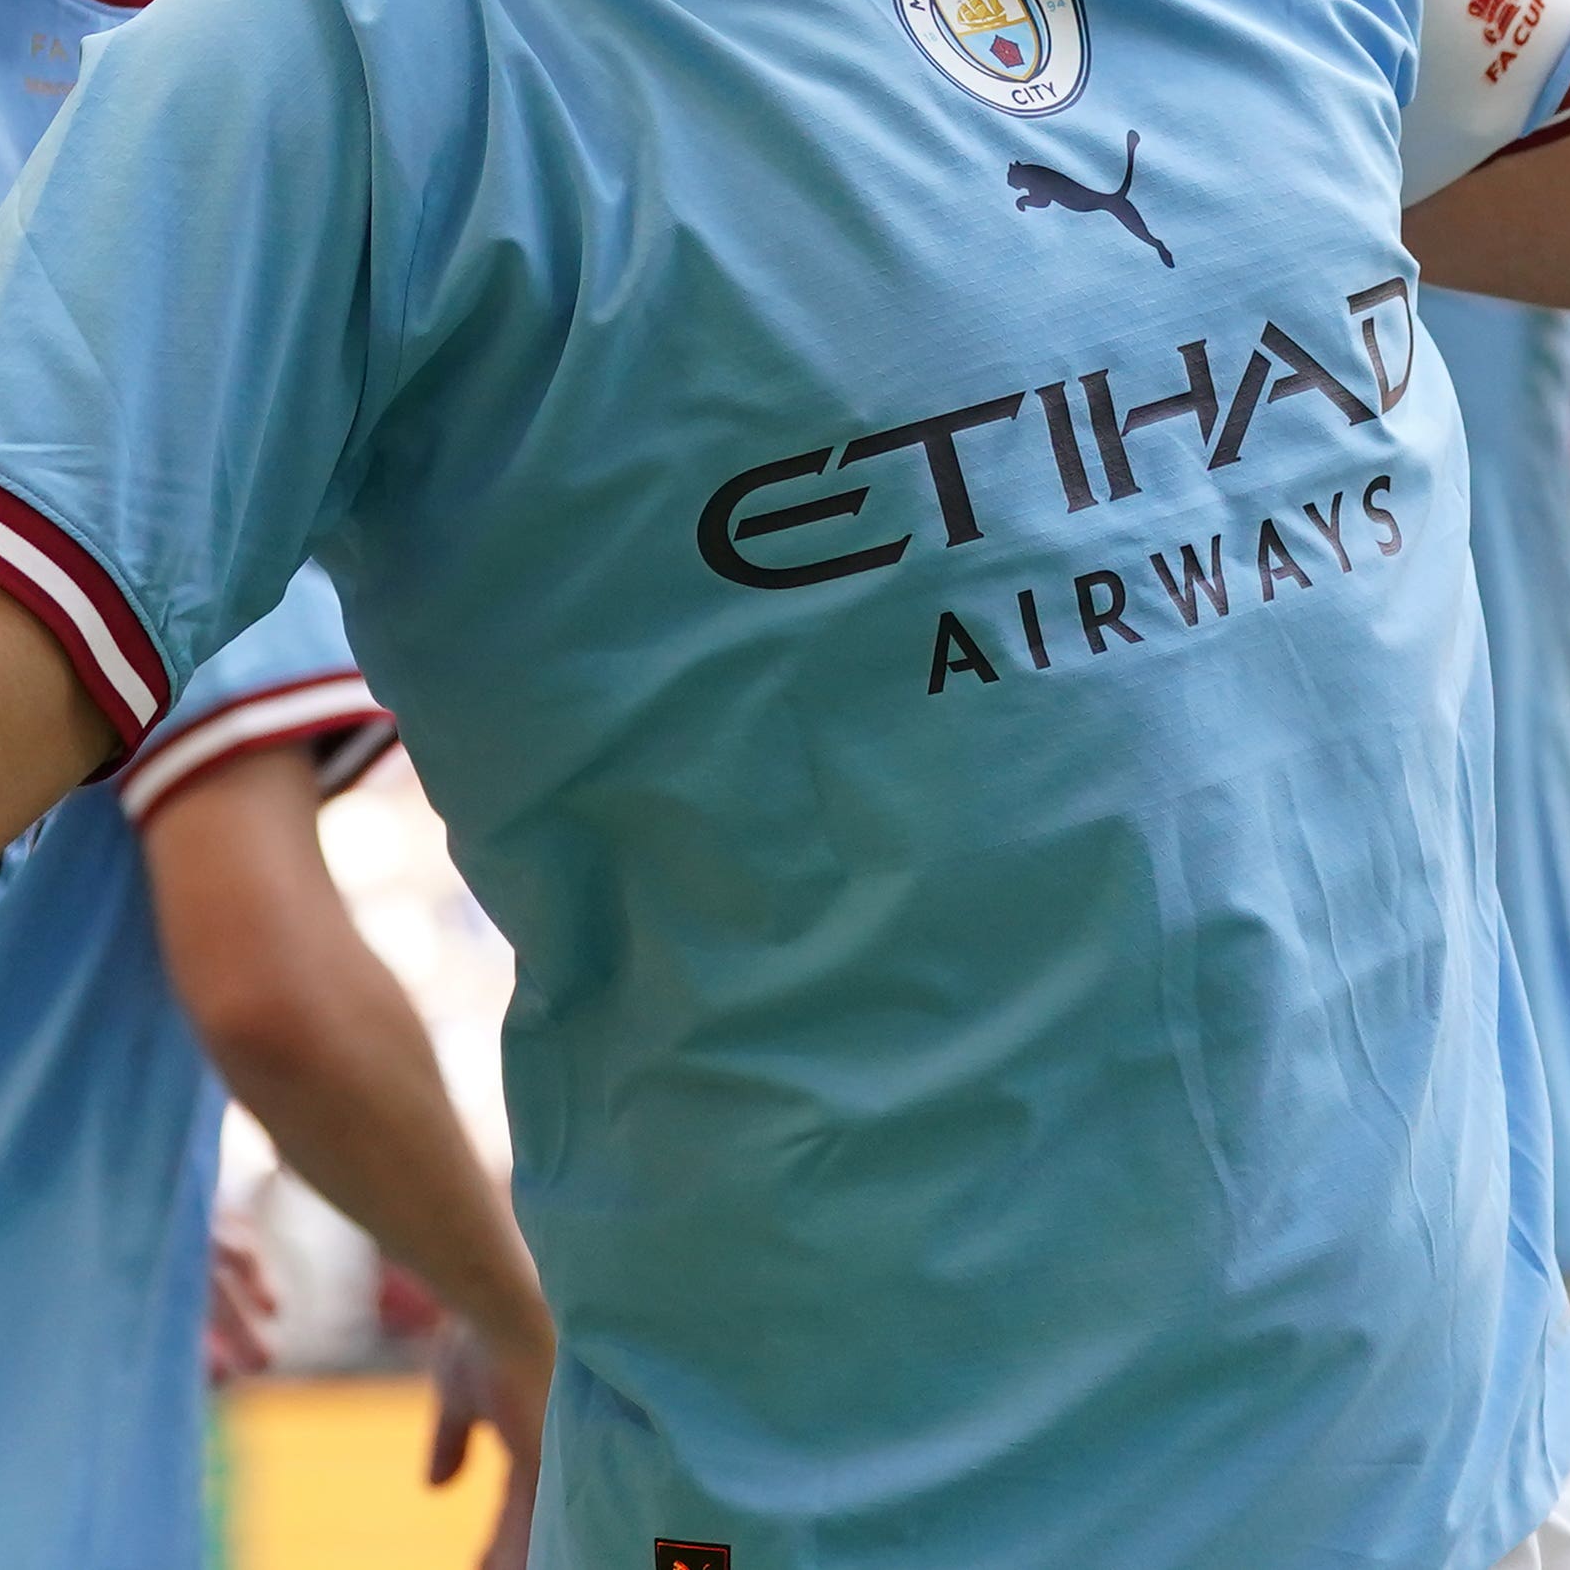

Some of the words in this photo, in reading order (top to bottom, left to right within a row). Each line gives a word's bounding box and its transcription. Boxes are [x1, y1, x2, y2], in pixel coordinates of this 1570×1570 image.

[1011, 81, 1058, 106] CITY
[1485, 50, 1518, 85] FA
[696, 276, 1415, 590] ETIHAD
[927, 475, 1403, 696] AIRWAYS
